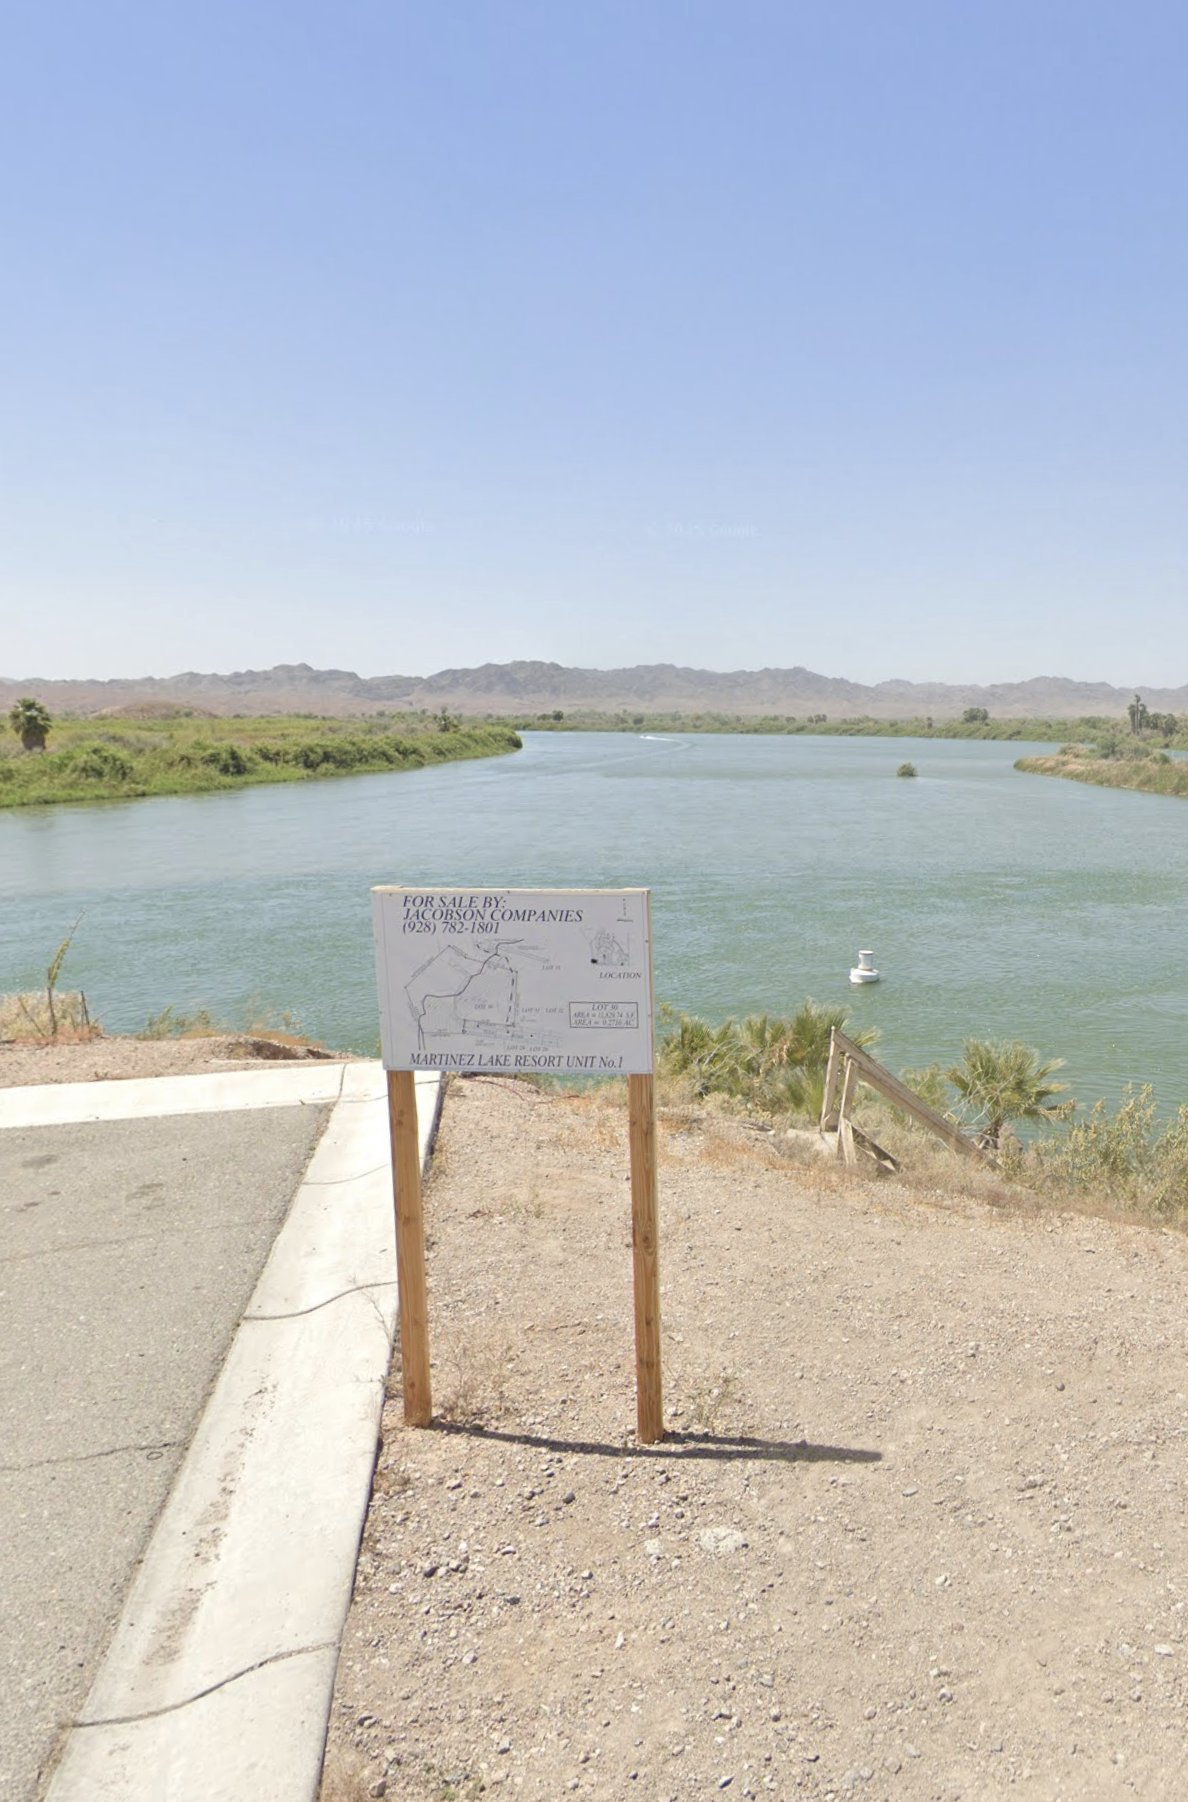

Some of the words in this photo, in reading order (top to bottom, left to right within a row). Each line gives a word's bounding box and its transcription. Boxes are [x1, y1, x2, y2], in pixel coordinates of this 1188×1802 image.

[402, 895, 436, 908] FOR
[437, 896, 479, 908] SALE
[482, 896, 506, 909] BY:
[402, 908, 488, 922] JACOBSON
[490, 909, 583, 922] COMPANIES
[402, 921, 437, 935] (928)
[442, 921, 500, 934] 782-1801
[599, 971, 642, 980] LOCATION
[409, 1052, 475, 1065] MARTINEZ
[478, 1053, 512, 1066] LAKE
[514, 1054, 564, 1067] RESORT
[565, 1055, 596, 1068] UNIT
[598, 1056, 624, 1069] No.1
